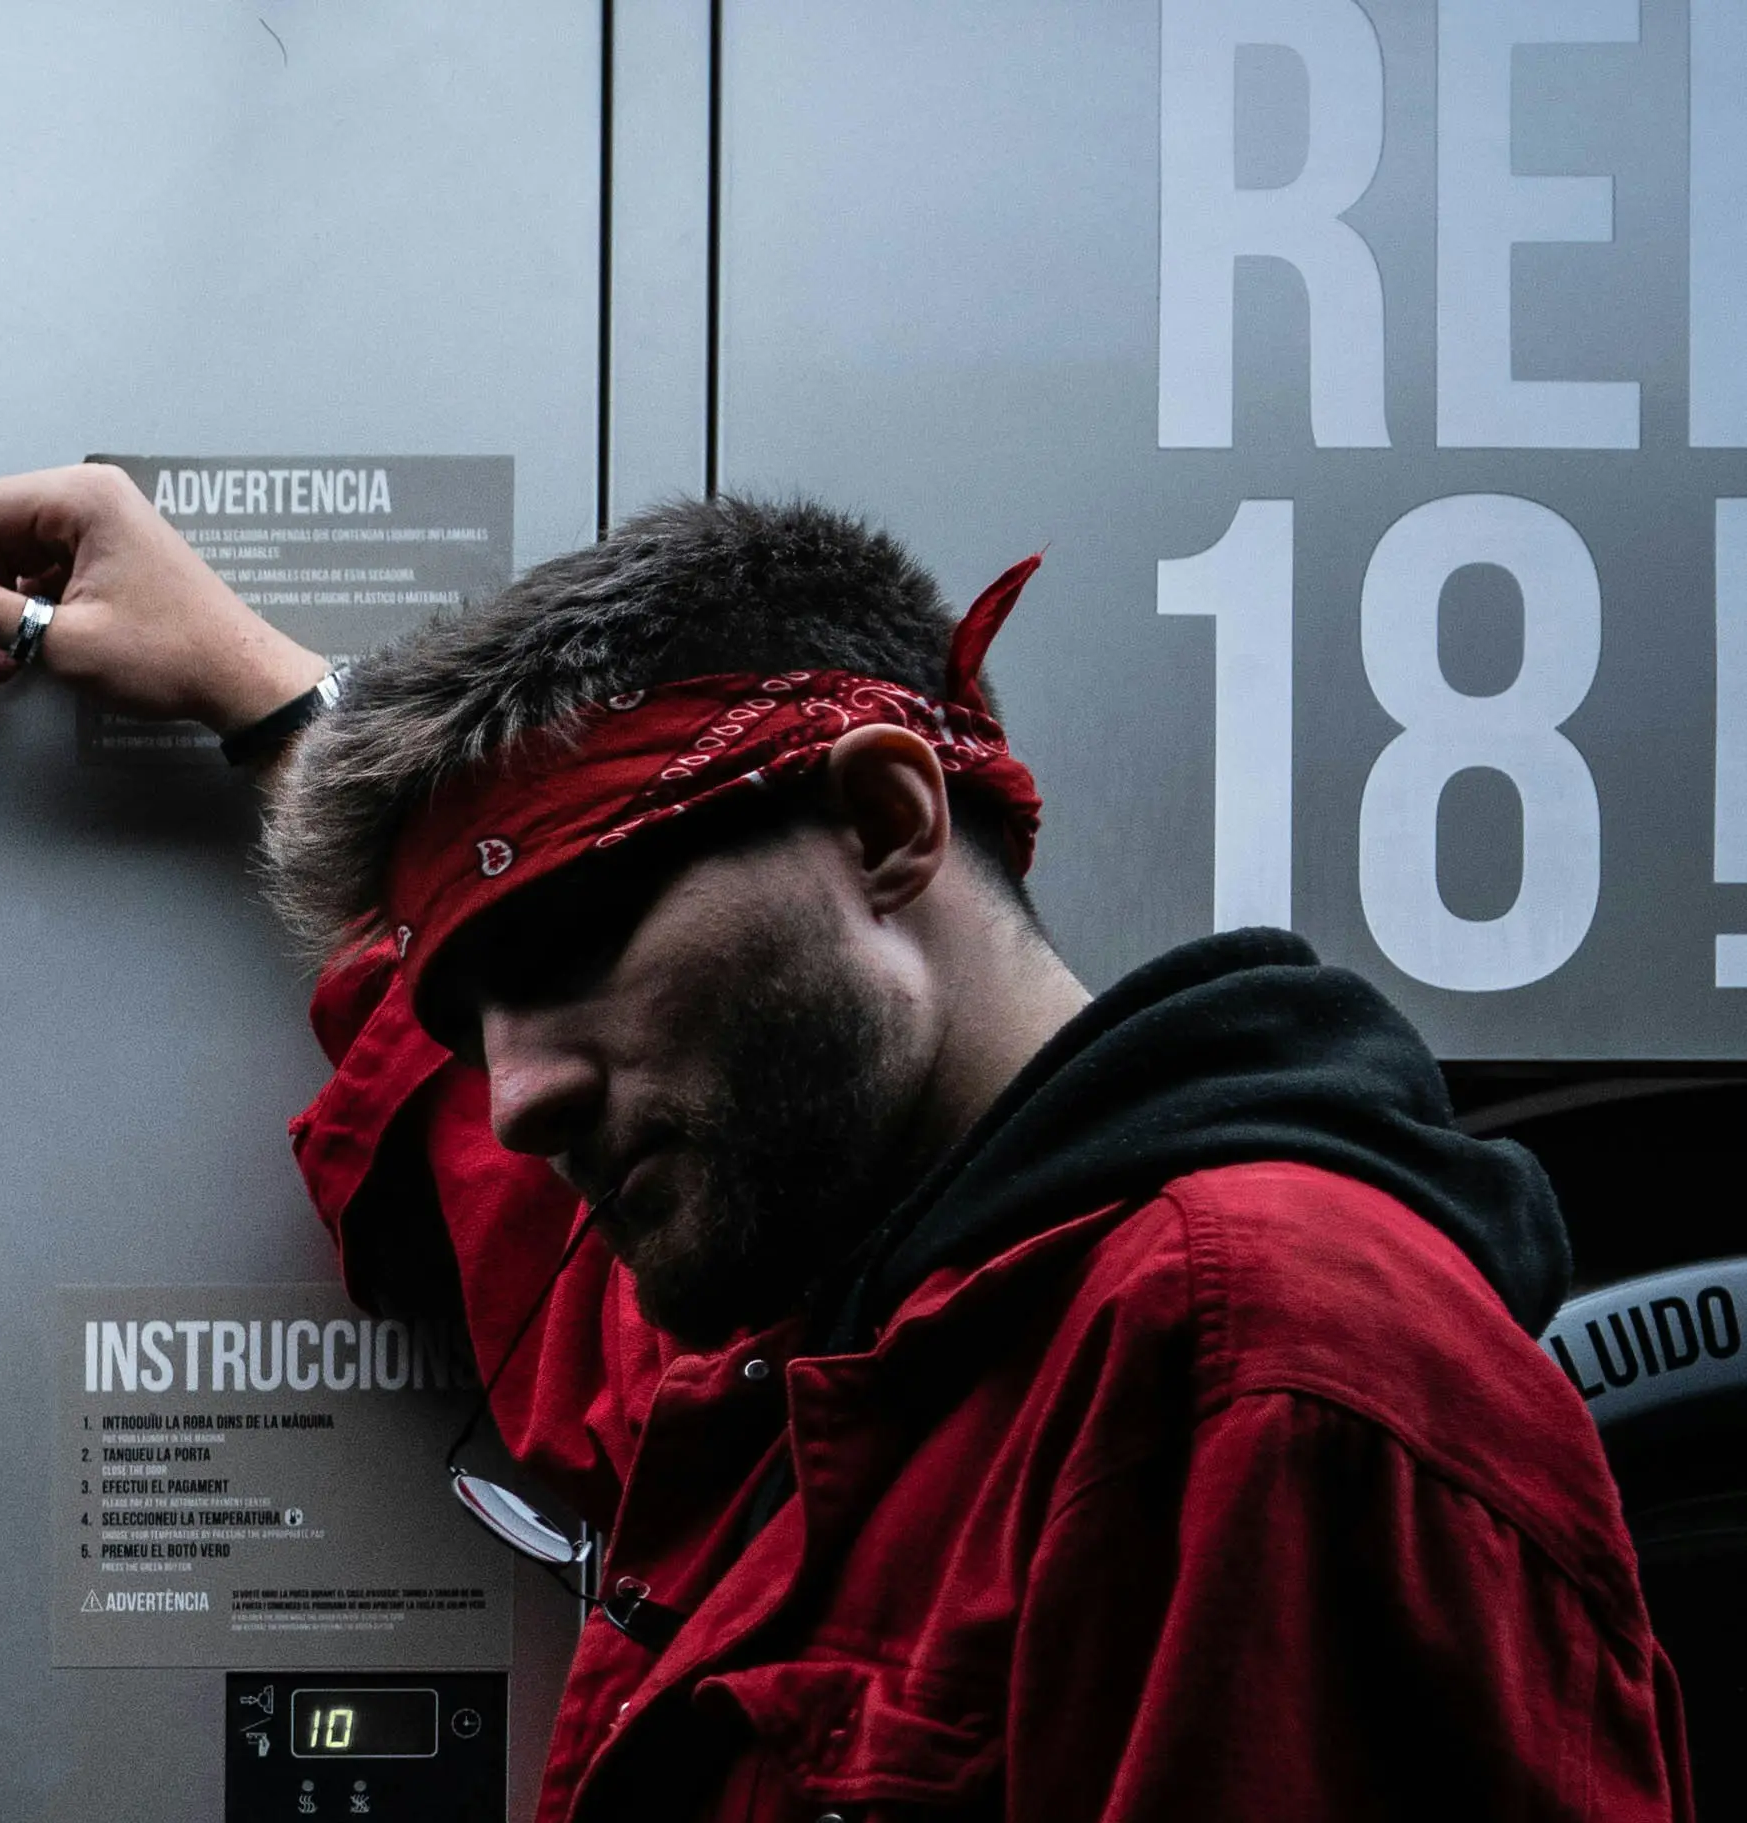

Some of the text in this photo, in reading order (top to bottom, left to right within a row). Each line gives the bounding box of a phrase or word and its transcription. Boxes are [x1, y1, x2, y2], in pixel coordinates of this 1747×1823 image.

[1157, 0, 1747, 449] RE
[154, 469, 392, 515] ADVERTENCIA
[1156, 492, 1602, 992] 18
[1550, 1286, 1741, 1400] LUIDO
[83, 1416, 93, 1430] 1.
[165, 1416, 180, 1430] LA
[183, 1416, 214, 1430] ROBA
[216, 1416, 243, 1430] DINS
[245, 1416, 261, 1430] DE
[263, 1416, 279, 1430] LA
[81, 1447, 211, 1461] 2. TANQUEU LA PORTA
[102, 1465, 126, 1476] CLOSE
[129, 1465, 144, 1476] THE
[81, 1479, 229, 1494] 3. EFECTUI EL PAGAMENT
[81, 1511, 281, 1525] 4. SELECCIONEU LA TEMPERATURA
[81, 1541, 231, 1558] 5. PREMEU EL BOTÓ VERD
[309, 1709, 354, 1748] 10
